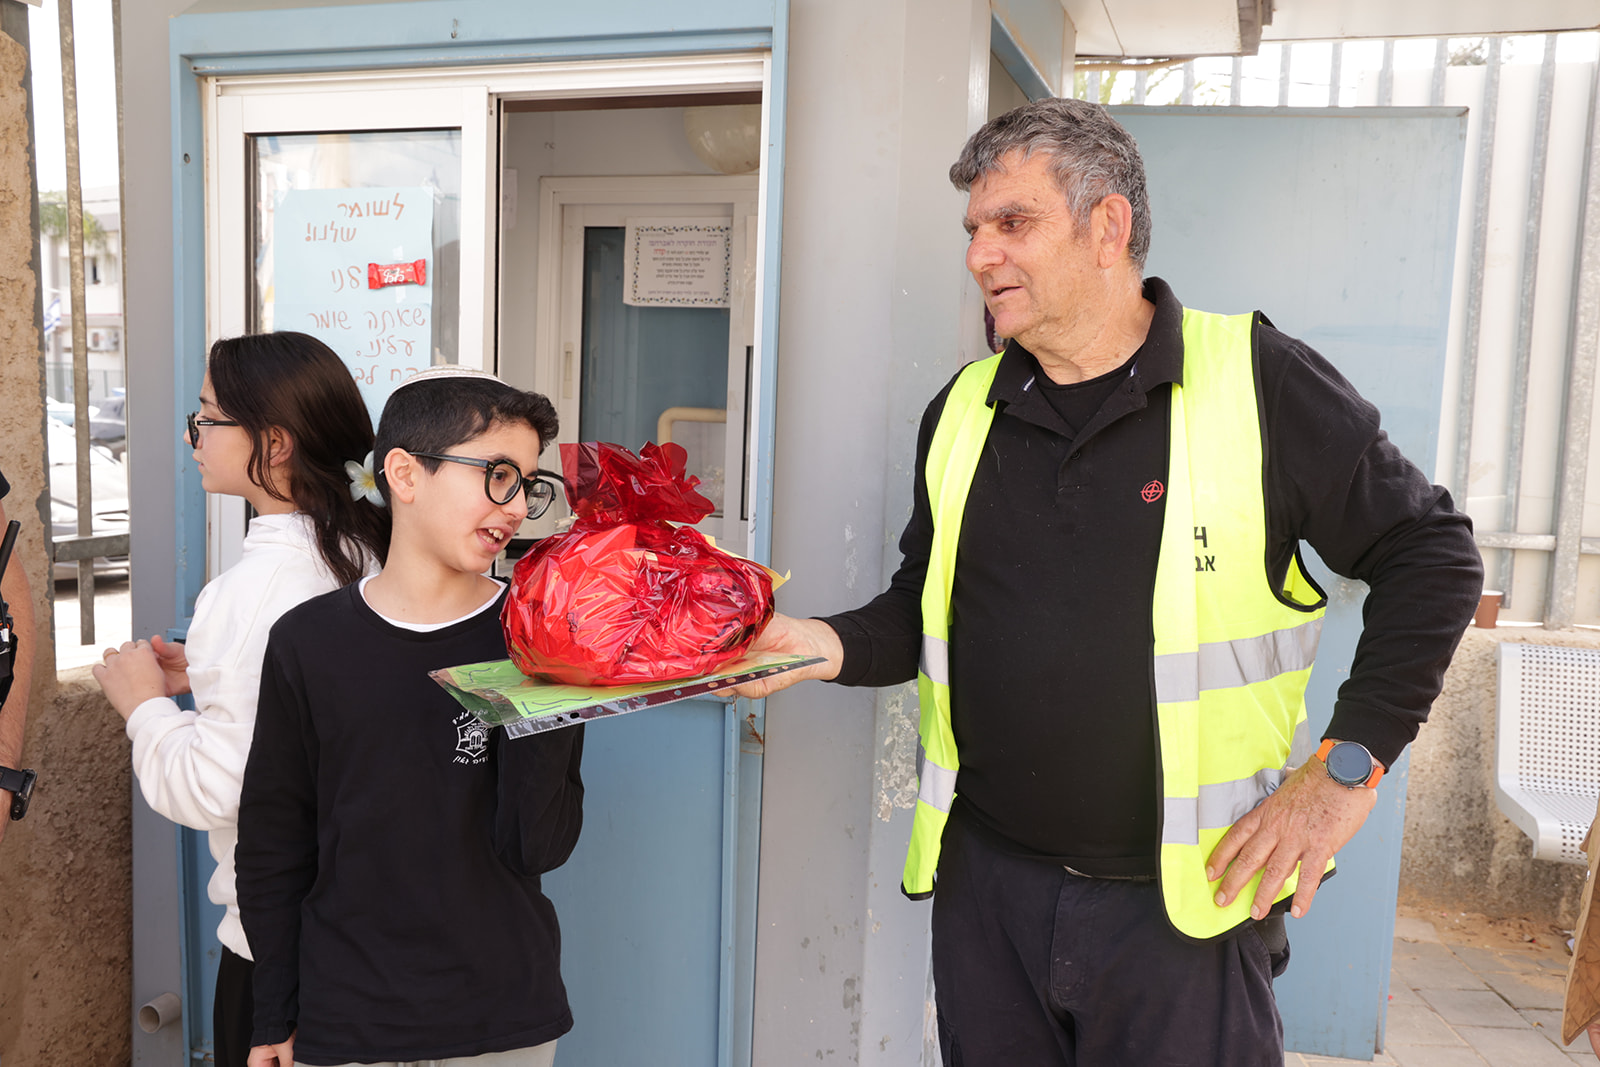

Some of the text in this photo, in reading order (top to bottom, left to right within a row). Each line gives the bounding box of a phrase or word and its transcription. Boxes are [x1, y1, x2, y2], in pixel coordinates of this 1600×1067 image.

[336, 192, 405, 221] לשומר
[305, 220, 357, 243] שלנו!
[307, 307, 426, 337] שאתה שומר
